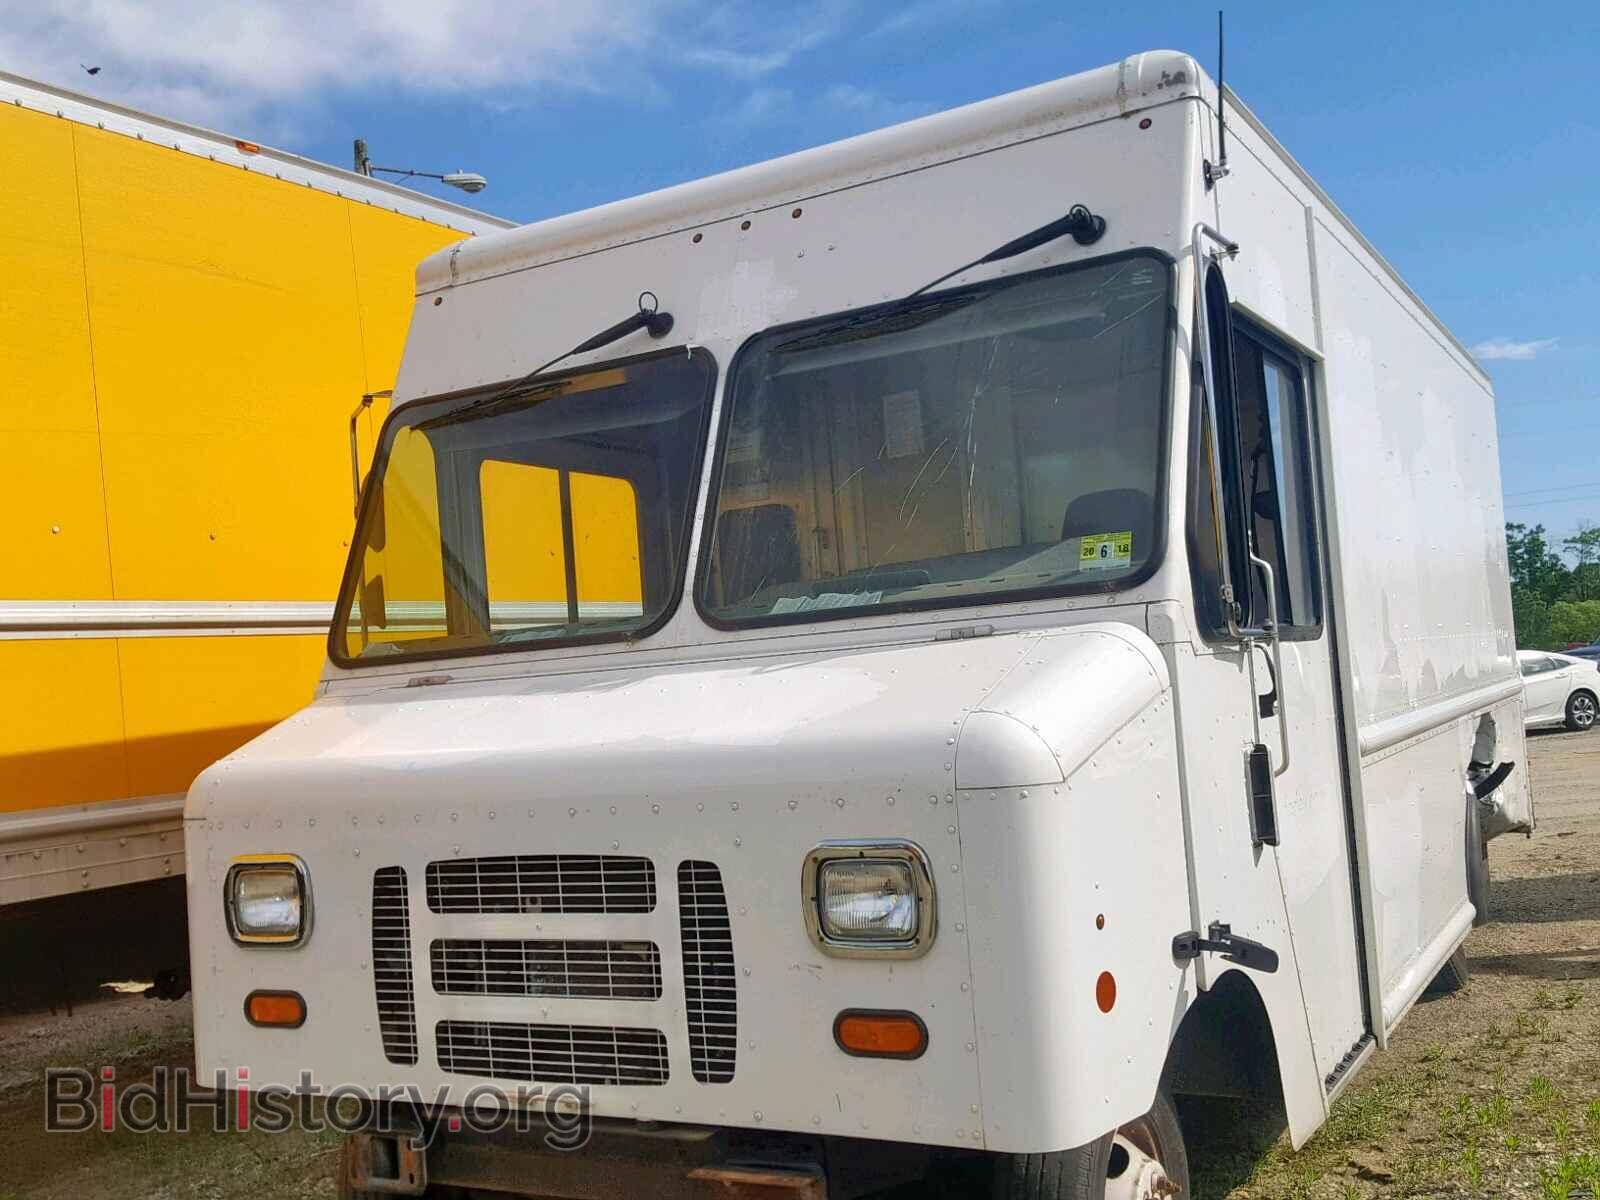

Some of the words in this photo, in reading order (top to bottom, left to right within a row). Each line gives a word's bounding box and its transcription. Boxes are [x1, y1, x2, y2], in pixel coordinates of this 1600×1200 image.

[1082, 547, 1095, 557] 20
[1100, 544, 1108, 558] 6
[1118, 543, 1130, 553] 18
